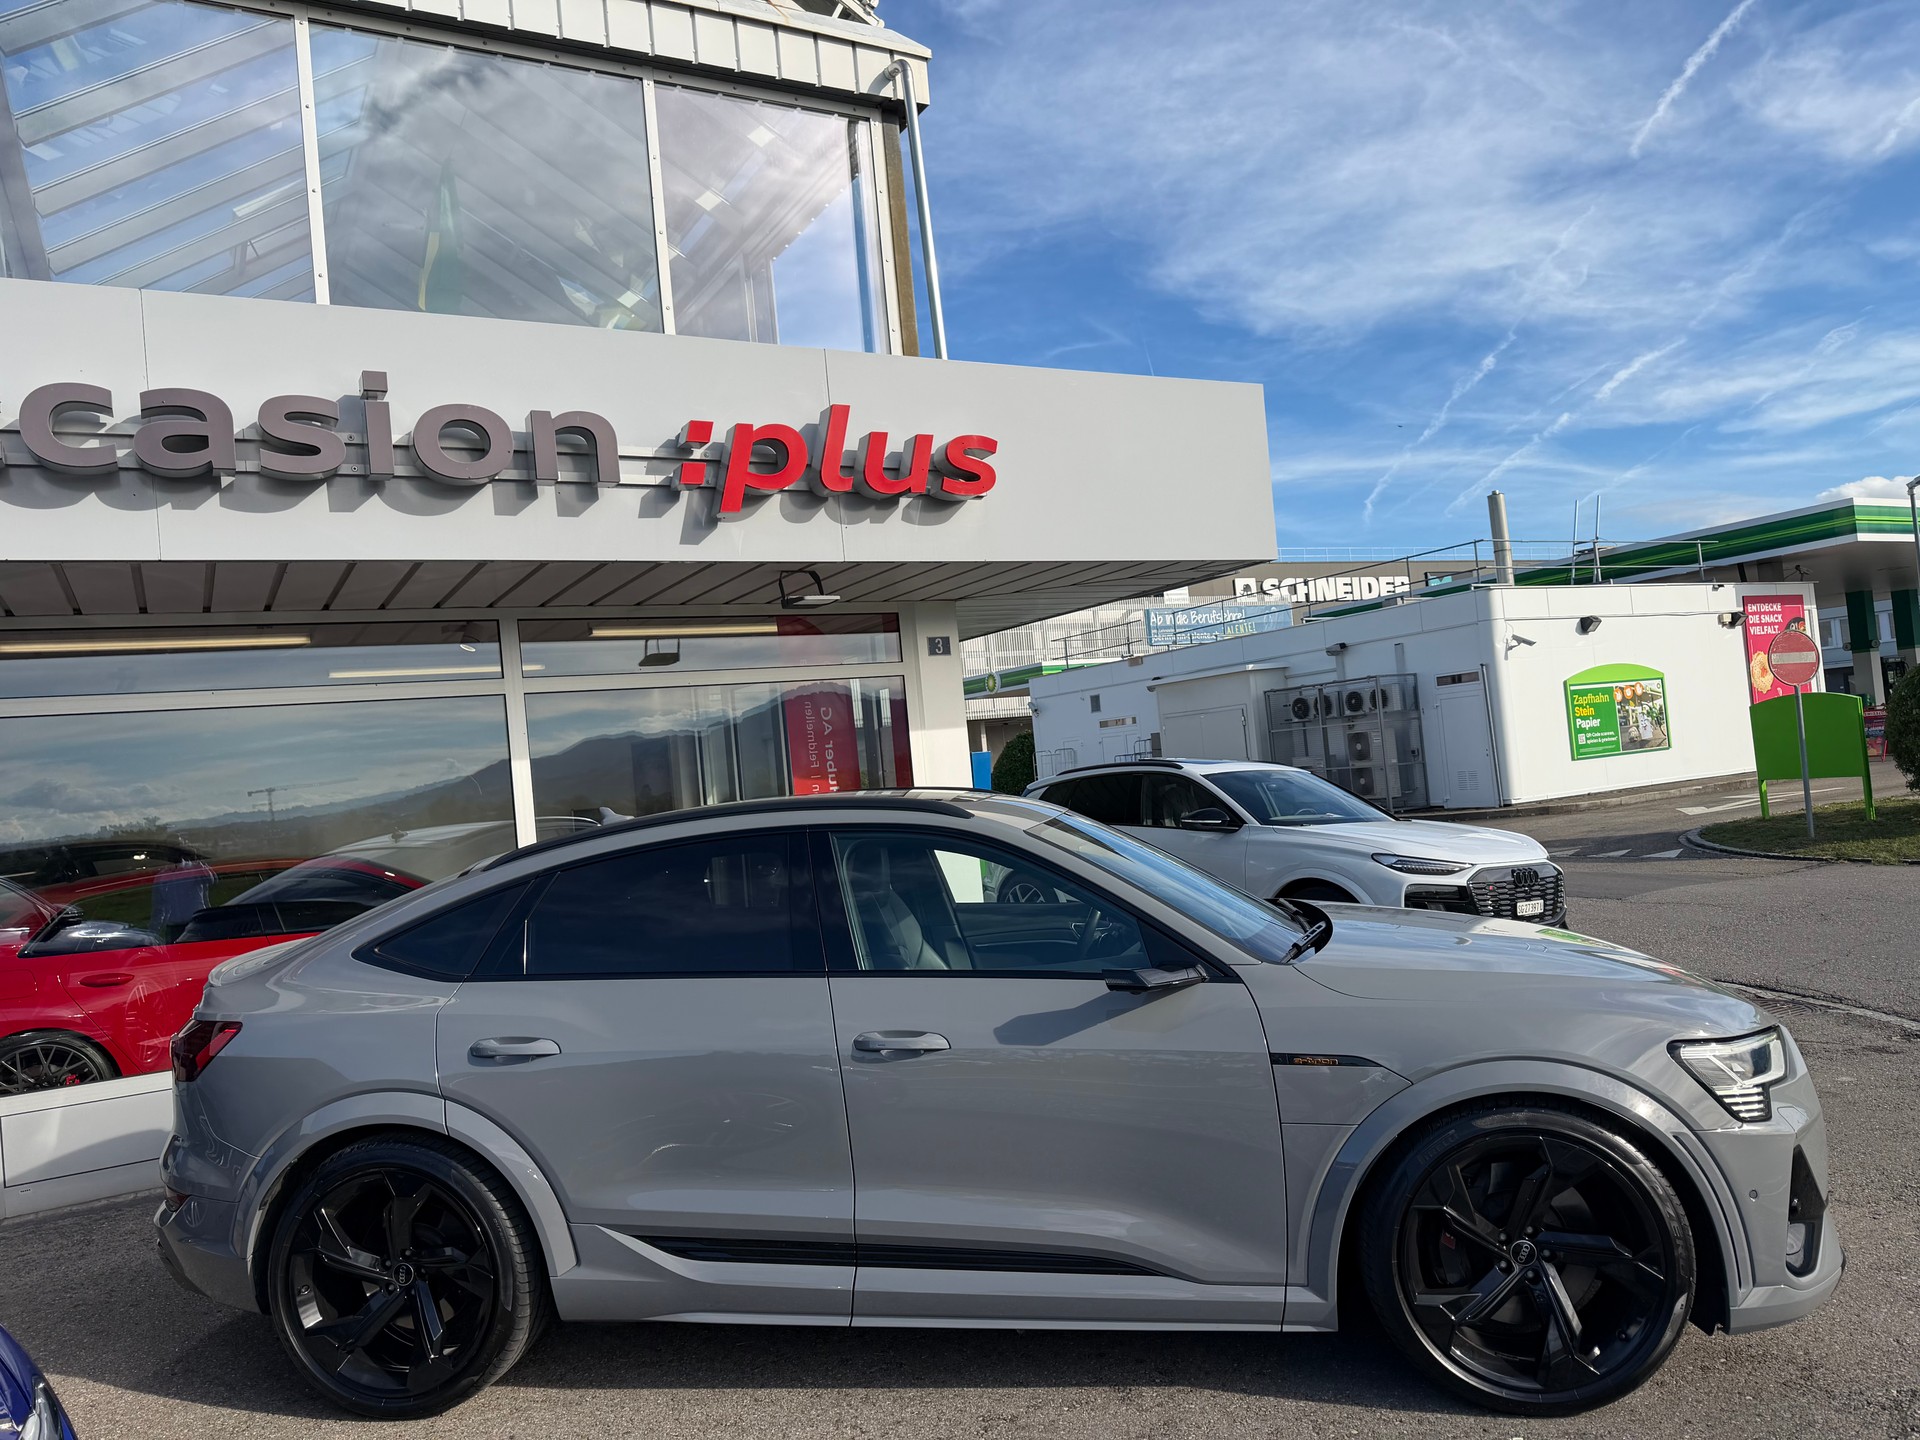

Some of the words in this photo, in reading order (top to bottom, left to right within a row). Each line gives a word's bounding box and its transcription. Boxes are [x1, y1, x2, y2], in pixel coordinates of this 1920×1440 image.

[0, 371, 620, 485] casion
[678, 404, 999, 514] :plus
[1262, 576, 1410, 602] SCHNEIDER
[1747, 603, 1782, 612] ENTDECKE
[1150, 612, 1163, 625] Ab
[1165, 612, 1174, 624] in
[1176, 611, 1188, 624] die
[1190, 609, 1246, 624] Berufslehre!
[1748, 615, 1760, 624] DIE
[1761, 614, 1783, 623] SNACK
[1749, 625, 1781, 635] VIELFALT.
[935, 638, 943, 654] 3
[1573, 693, 1610, 706] Zapfhahn
[1575, 706, 1595, 717] Stein
[1576, 717, 1601, 730] Papier
[1293, 1056, 1339, 1065] e-tron
